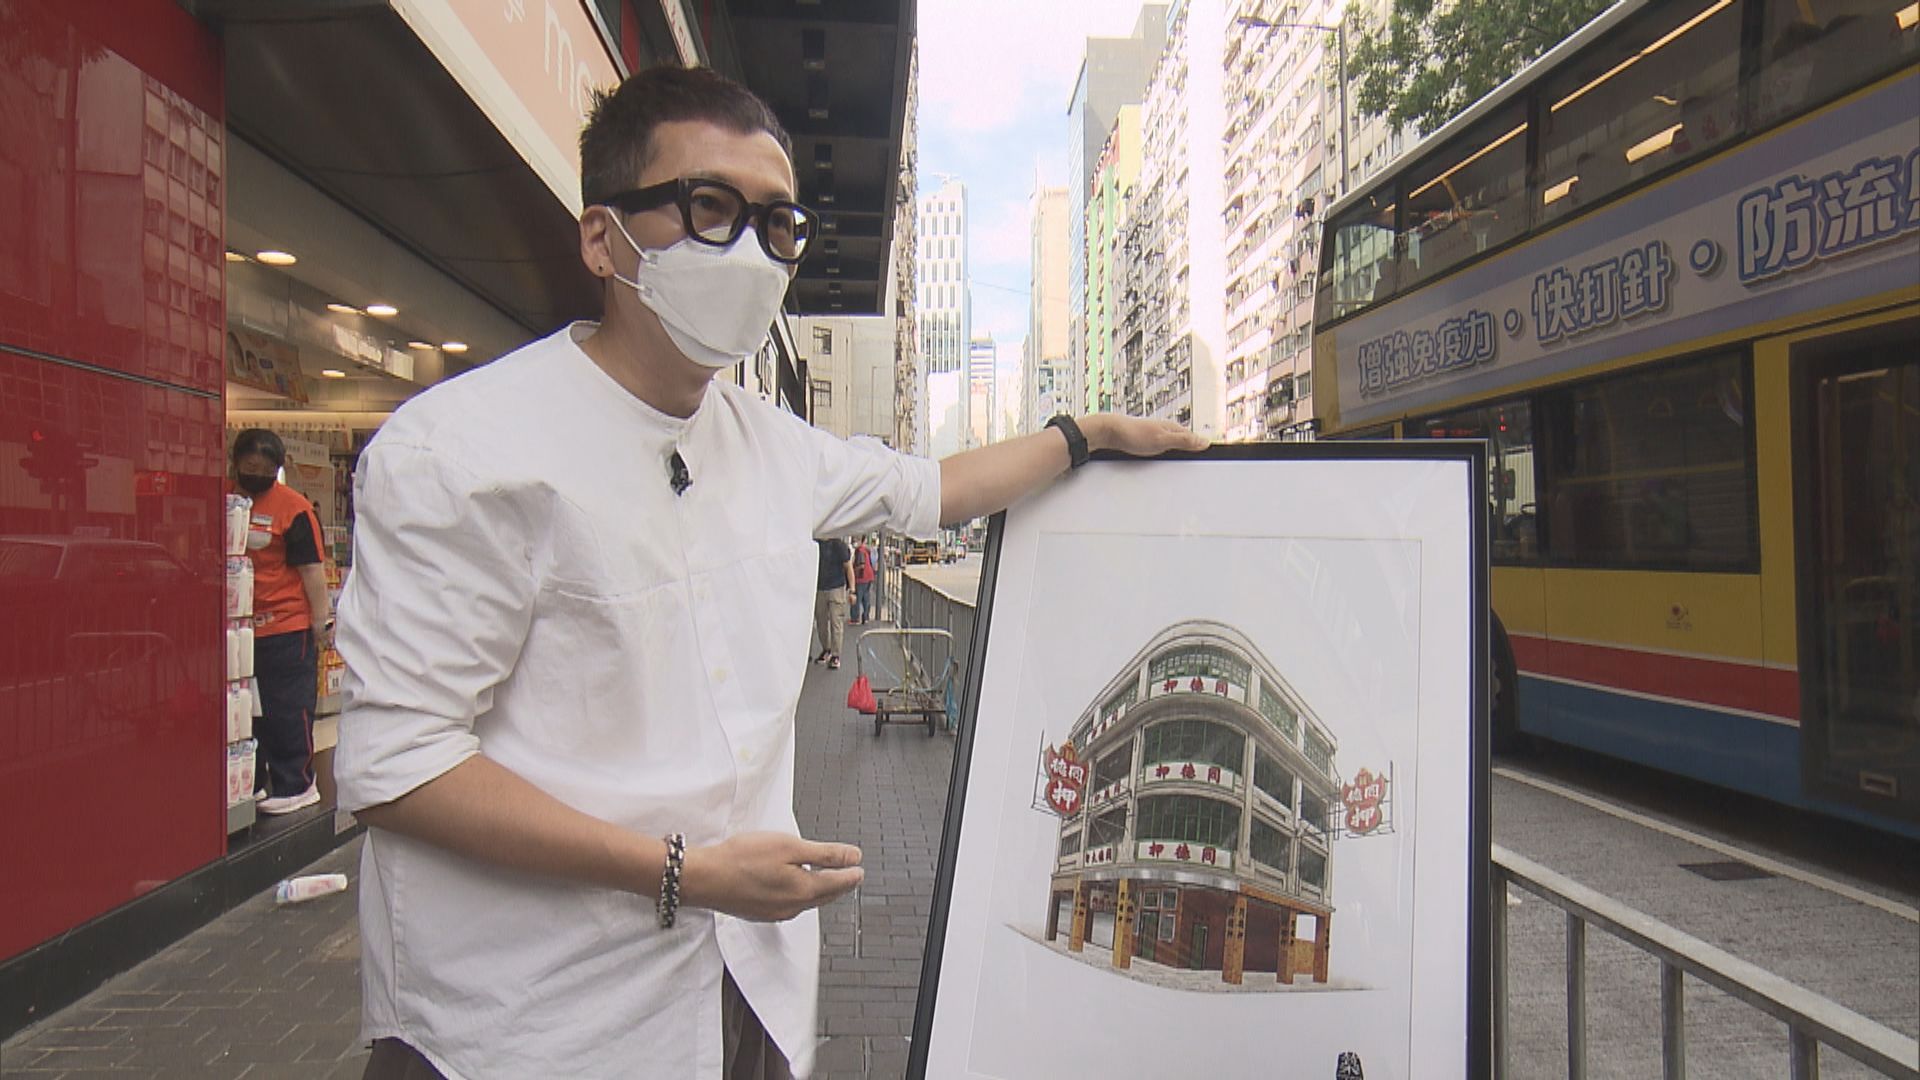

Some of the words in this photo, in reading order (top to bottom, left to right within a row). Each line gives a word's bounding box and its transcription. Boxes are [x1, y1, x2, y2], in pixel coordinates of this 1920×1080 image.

[1359, 311, 1496, 393] 增強免疫力
[1532, 240, 1668, 342] 快打針
[1738, 147, 1920, 282] 防流
